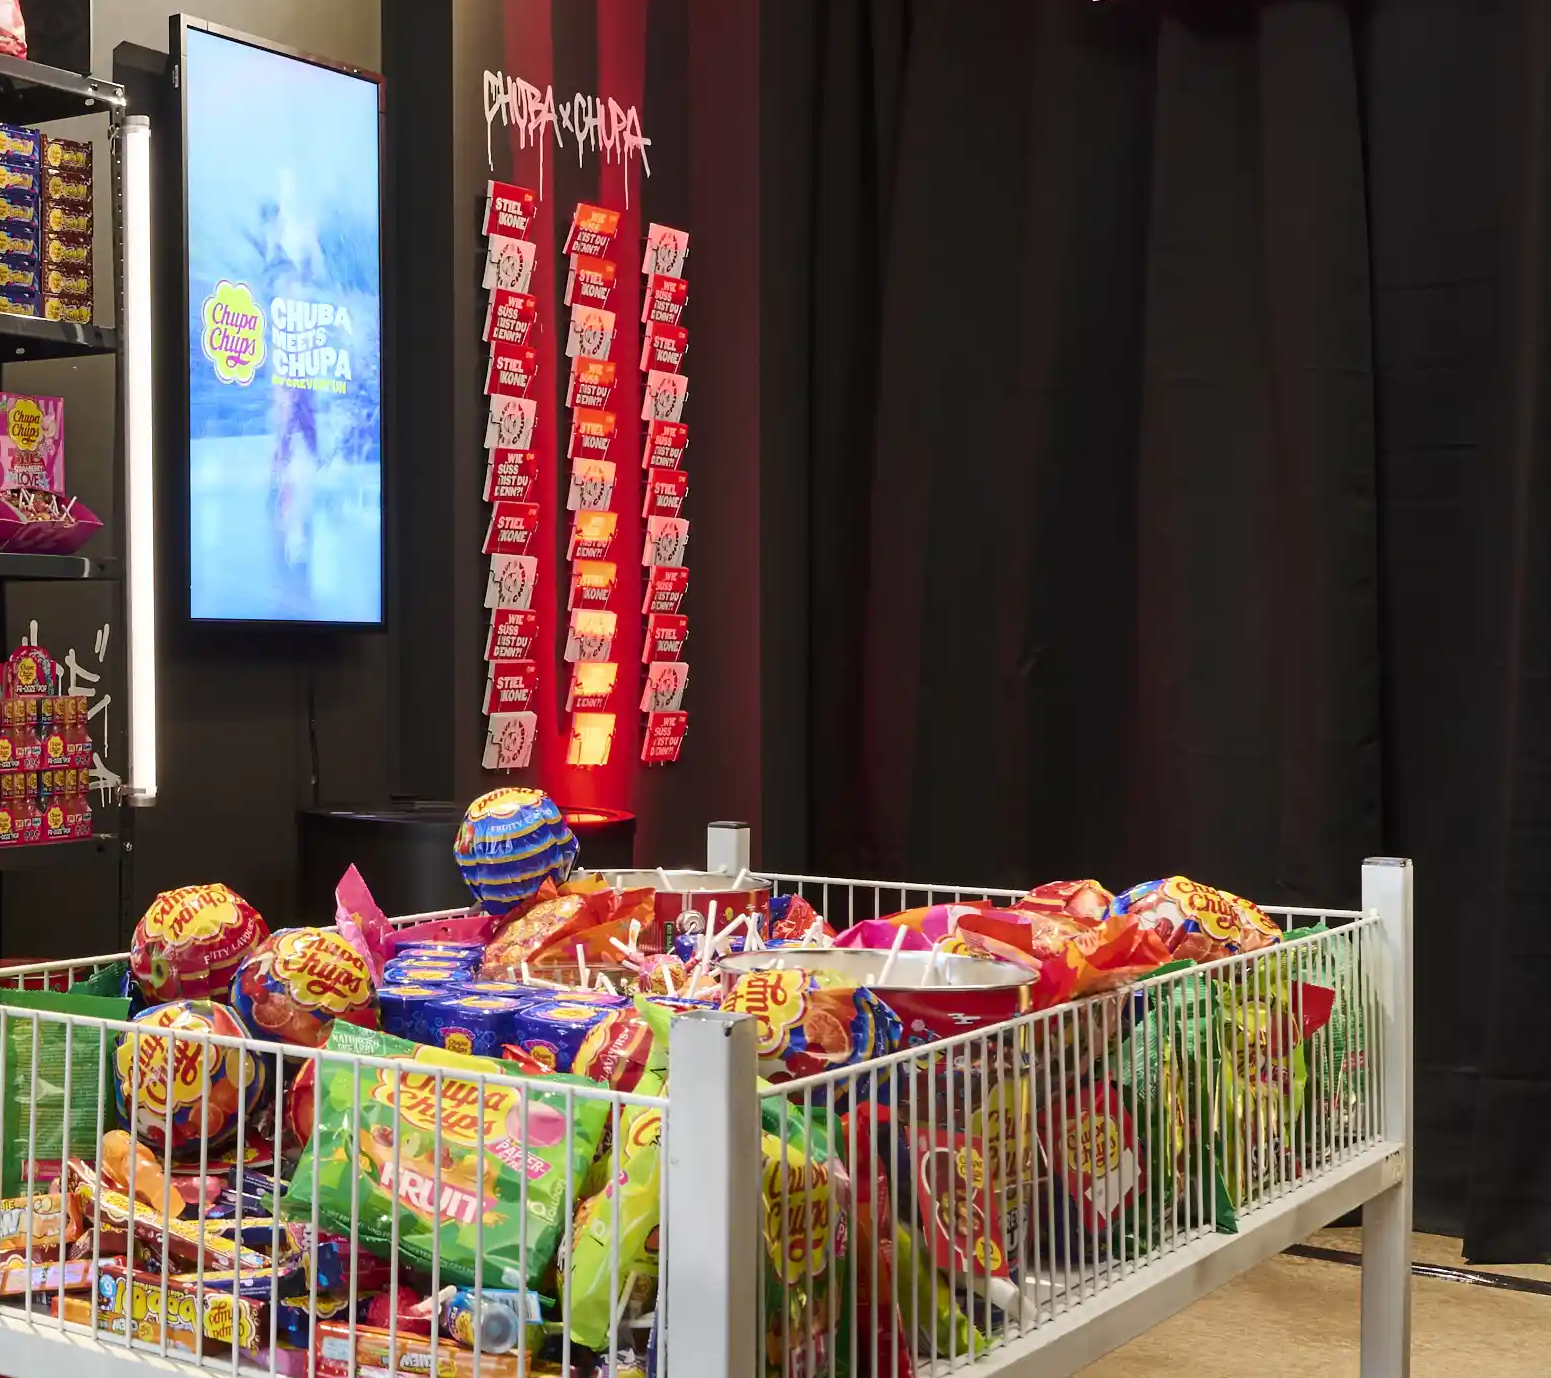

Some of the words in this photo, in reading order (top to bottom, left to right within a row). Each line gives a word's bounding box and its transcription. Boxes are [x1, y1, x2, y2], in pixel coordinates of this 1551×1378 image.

[213, 302, 258, 332] Chupa
[272, 296, 349, 332] CHUBA
[210, 328, 256, 367] Chups
[273, 329, 326, 350] MEETS
[273, 349, 352, 381] CHUPA
[12, 423, 40, 443] Chups
[14, 410, 40, 425] Chupa
[381, 1161, 485, 1223] FRUIT
